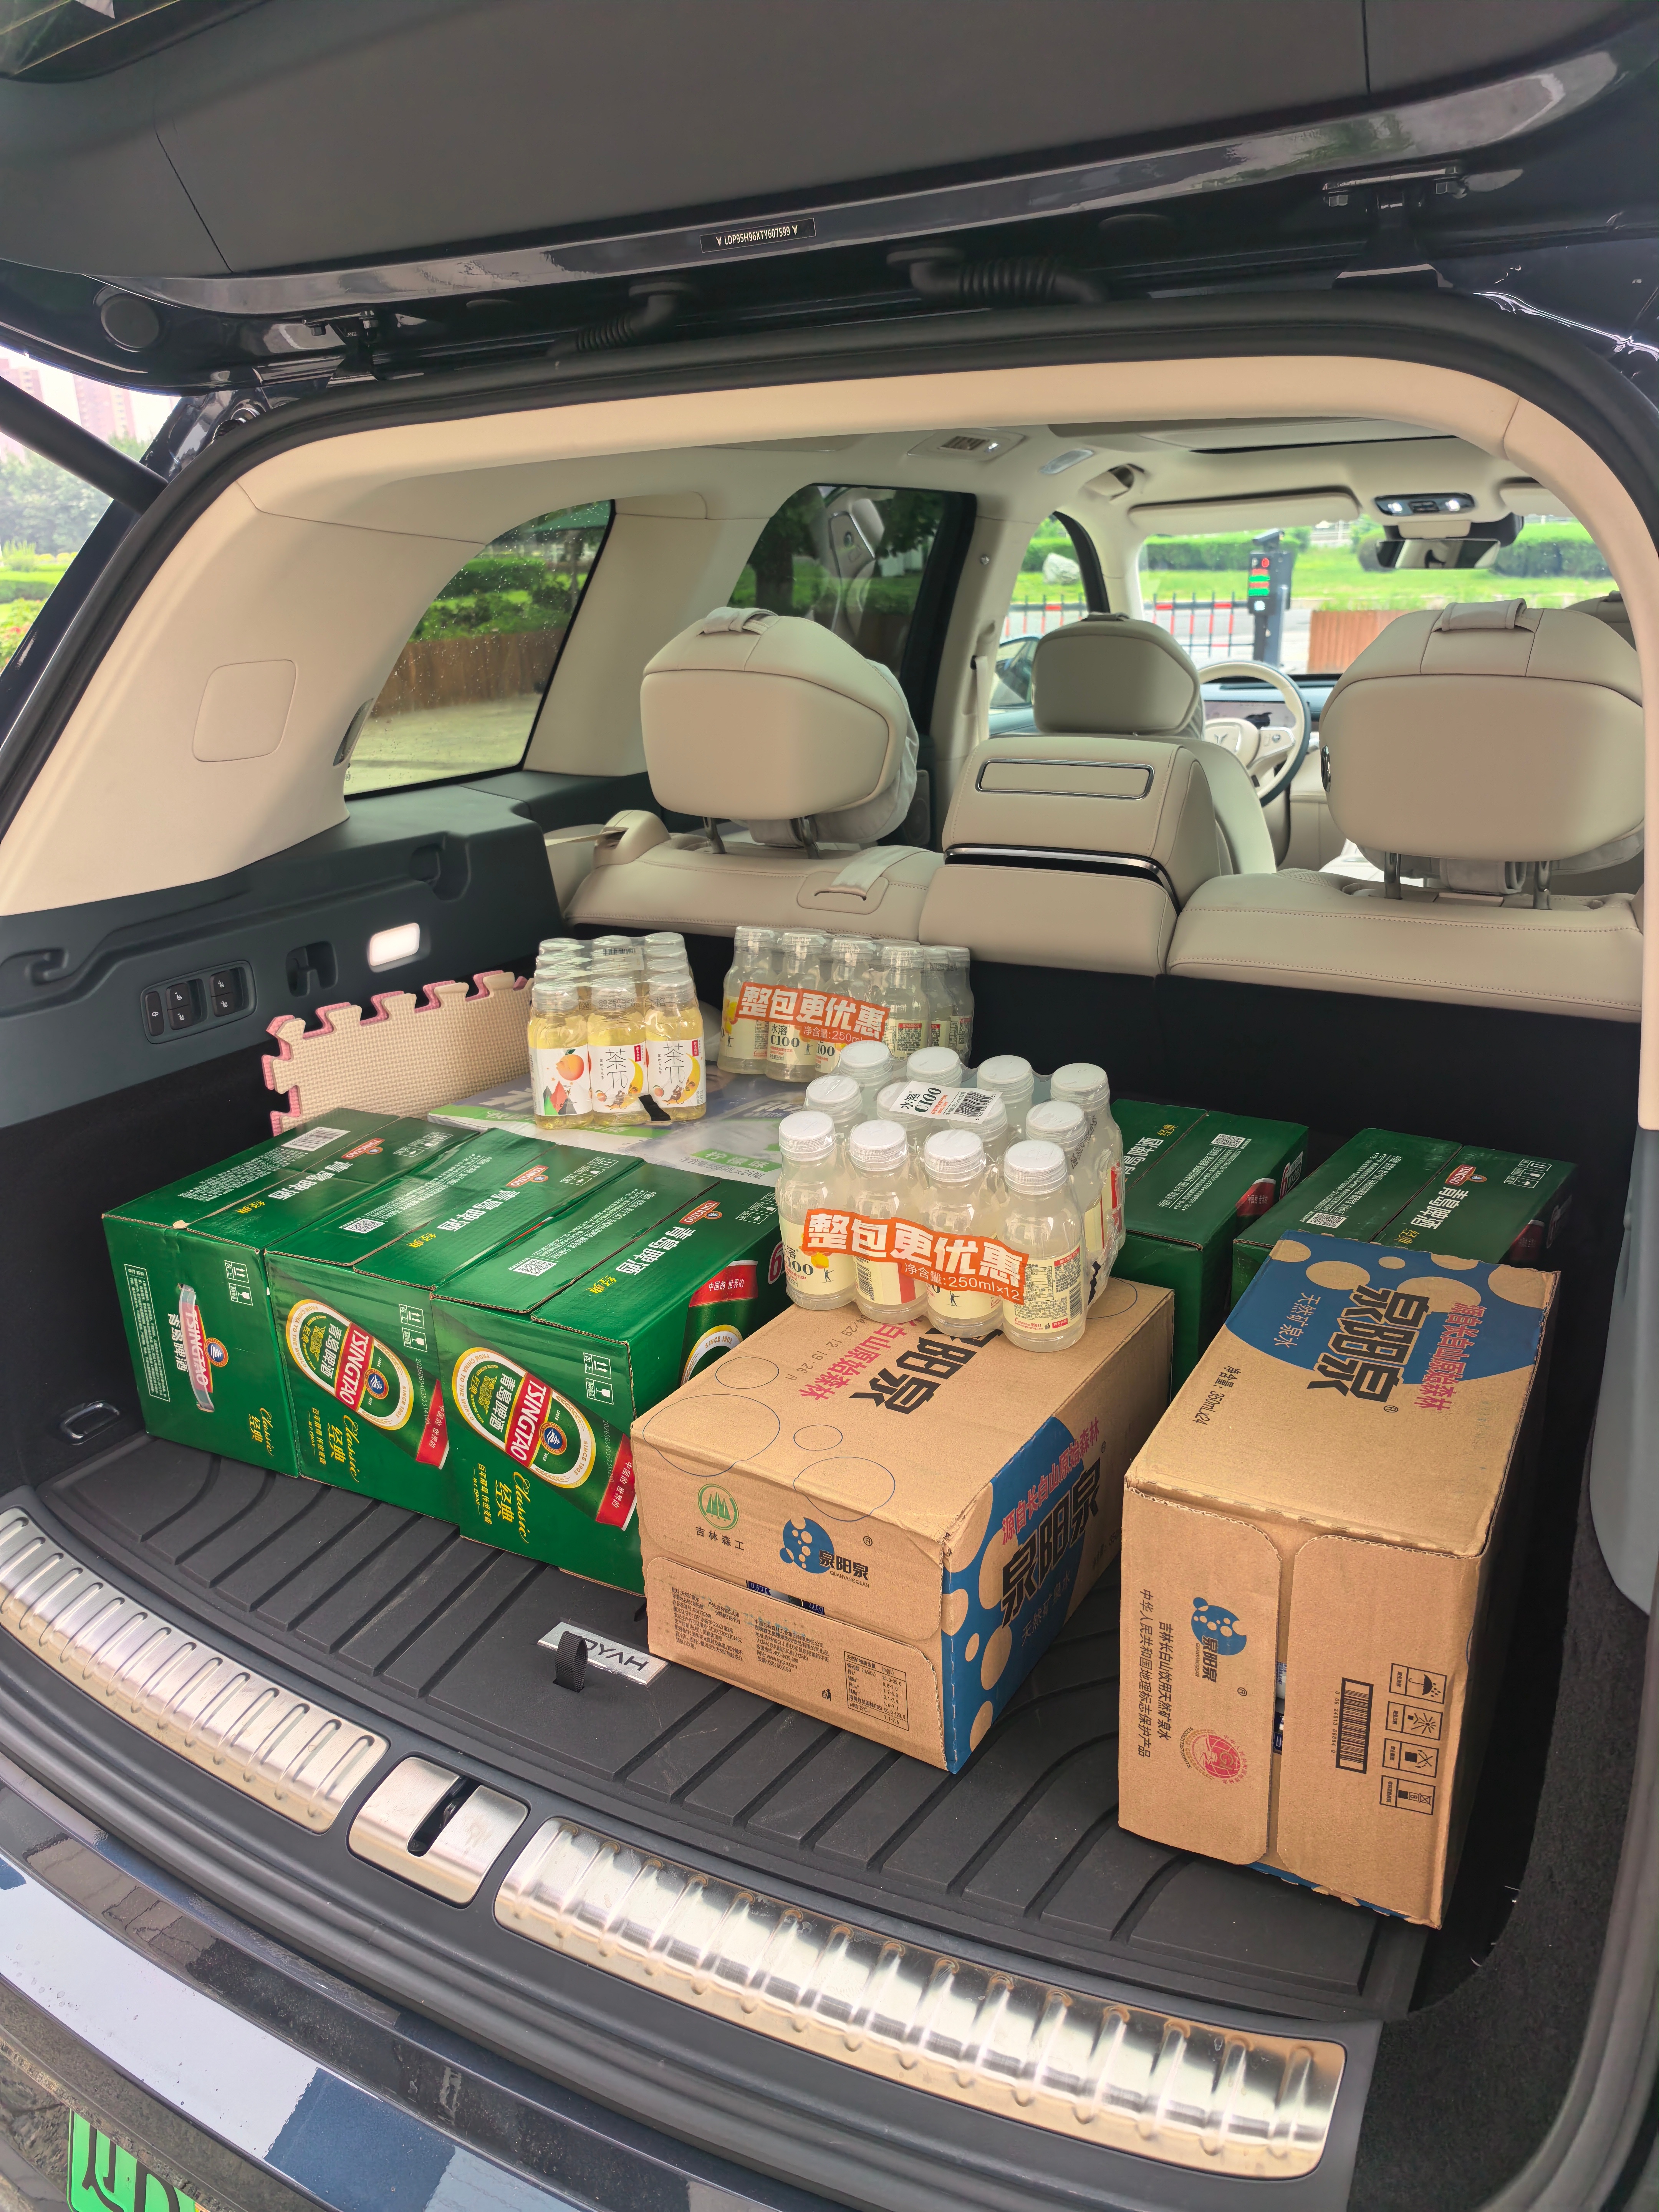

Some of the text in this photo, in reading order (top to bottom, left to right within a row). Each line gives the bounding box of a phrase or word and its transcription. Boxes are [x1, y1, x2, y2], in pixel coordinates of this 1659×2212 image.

[725, 226, 790, 245] LDP95H96XTY607599
[738, 986, 887, 1039] 整包更优惠
[772, 1024, 788, 1036] 水溶
[900, 1093, 921, 1109] 水溶
[914, 1088, 942, 1113] C100
[1157, 1124, 1179, 1136] 经典
[346, 1139, 382, 1158] TSINGTAO
[268, 1161, 354, 1200] 青岛啤酒
[510, 1166, 547, 1187] TSINGTAO
[1451, 1166, 1472, 1183] TSINGTAO
[237, 1200, 265, 1214] 经典
[437, 1190, 520, 1232] 青岛啤酒
[682, 1202, 717, 1224] TSINGTAO
[1411, 1187, 1469, 1230] 青岛啤酒
[409, 1233, 437, 1248] 经典
[808, 1214, 1022, 1287] 整包更优惠
[1393, 1229, 1422, 1244] 经典
[616, 1227, 696, 1276] 青岛啤酒
[589, 1276, 618, 1294] 经典
[709, 1279, 744, 1292] 中国的 世界的
[295, 1310, 306, 1324] CHINA
[400, 1307, 407, 1321] 向上
[1273, 1292, 1320, 1348] 天然矿泉水
[168, 1313, 188, 1372] 青岛啤酒
[301, 1324, 311, 1344] 经典
[705, 1338, 721, 1349] SINCE
[1307, 1285, 1430, 1403] 泉阳泉
[295, 1347, 307, 1368] WORLD
[320, 1323, 342, 1379] 青岛啤酒
[585, 1356, 592, 1370] 向上
[1414, 1301, 1486, 1411] 源自长白山原始森林
[339, 1330, 369, 1405] TSINGTAO
[460, 1374, 466, 1382] TO
[462, 1360, 476, 1373] CHINA
[469, 1375, 481, 1394] 经典
[396, 1405, 404, 1418] 1903
[462, 1398, 474, 1421] WORLD
[490, 1373, 516, 1433] 青岛啤酒
[249, 1414, 263, 1442] 经典
[260, 1408, 274, 1456] Classic
[429, 1405, 445, 1449] 中国的 世界的
[510, 1380, 547, 1460] TSINGTAO
[328, 1423, 346, 1463] 经典
[343, 1415, 360, 1482] Classic
[574, 1462, 584, 1476] 1903
[1002, 1417, 1101, 1545] 源自长白山原始森林
[478, 1463, 492, 1525] 百年酵母 传世麦香
[611, 1462, 632, 1508] 中国的 世界的
[495, 1479, 515, 1523] 经典
[513, 1472, 531, 1544] Classic
[695, 1526, 745, 1551] 吉林森工
[1001, 1457, 1101, 1628] 泉阳泉
[820, 1550, 869, 1581] 泉阳泉
[830, 1571, 869, 1588] QUANYANGQUAN
[1020, 1568, 1071, 1647] 天然矿泉水
[847, 1654, 894, 1676] 天然矿物质含量 (mg/L)
[1202, 1635, 1219, 1683] 泉阳泉
[1138, 1589, 1154, 1758] 中华人民共和国地理标志保护产品
[1158, 1621, 1174, 1741] 吉林长白山饮用天然矿泉水
